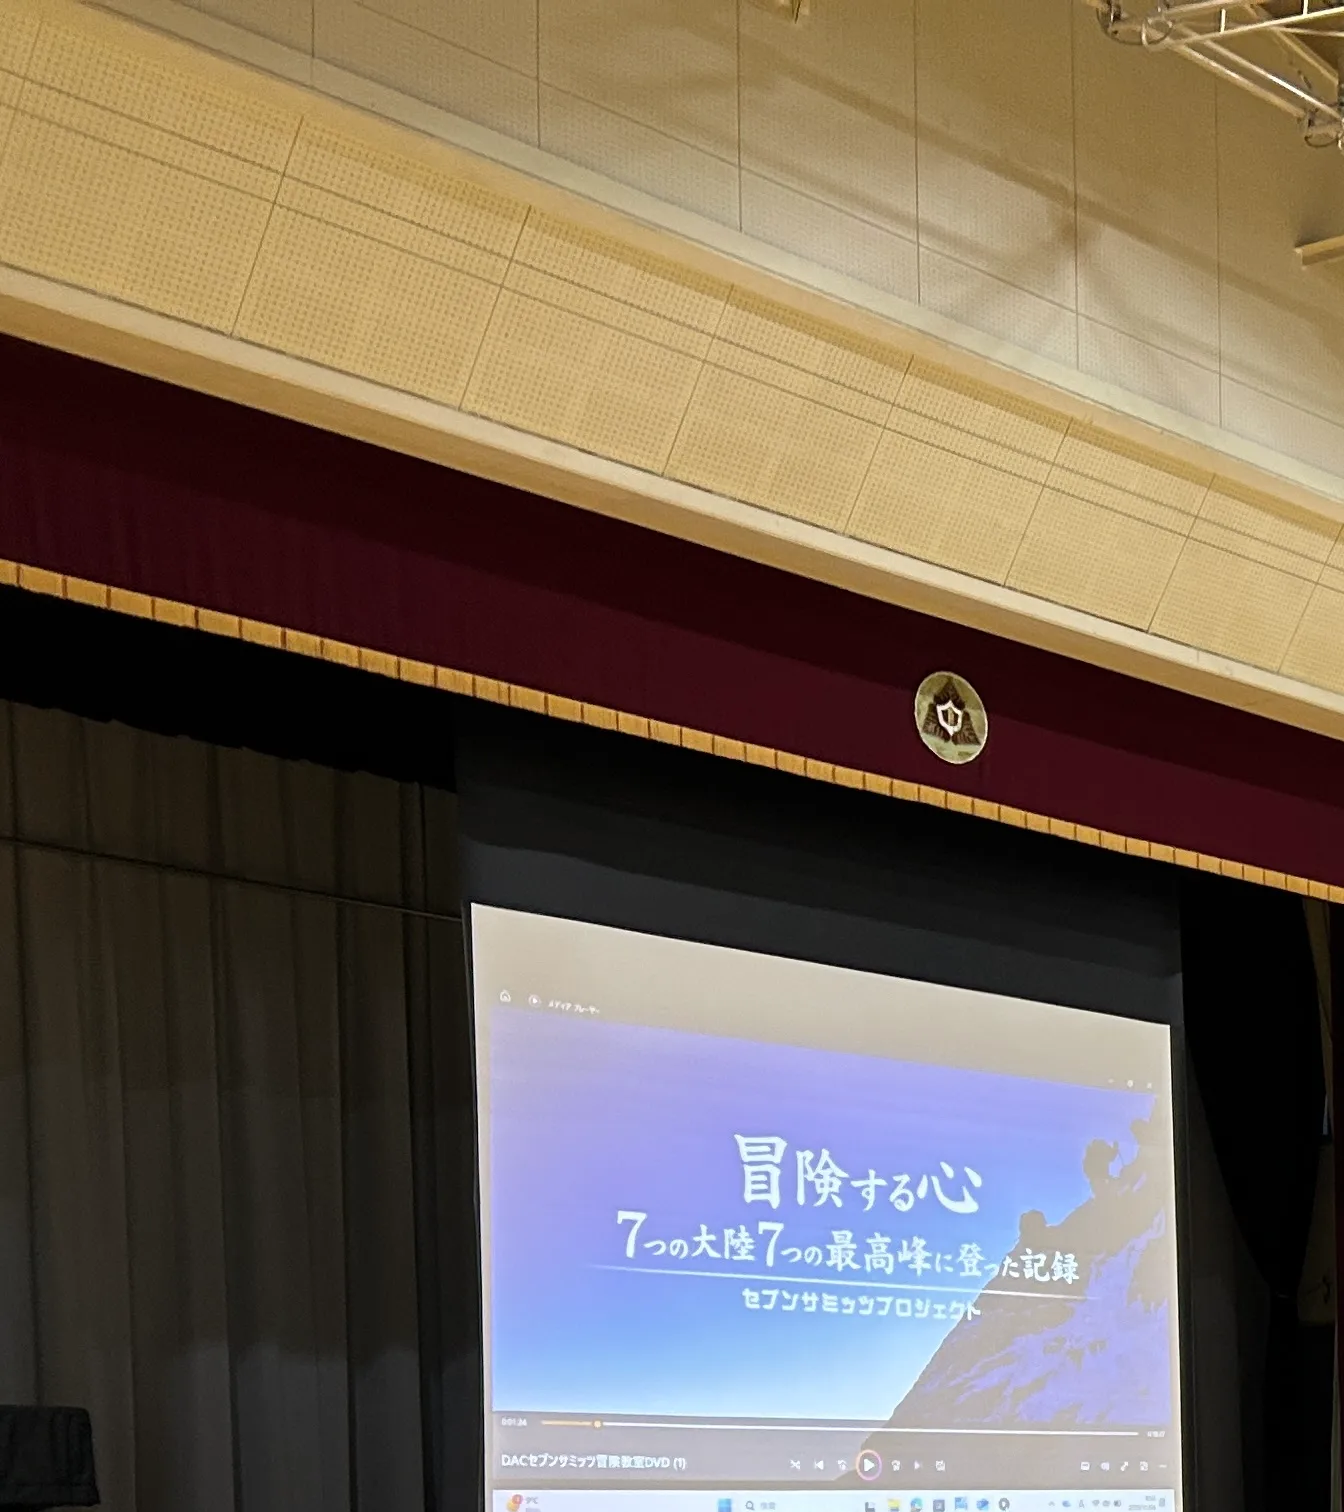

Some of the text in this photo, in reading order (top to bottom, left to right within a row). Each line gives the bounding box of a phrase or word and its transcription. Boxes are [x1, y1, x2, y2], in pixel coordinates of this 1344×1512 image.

[734, 1134, 983, 1213] 冒険する心
[616, 1210, 1080, 1285] 7つの大陸7つの最高峰に登った記録
[741, 1287, 981, 1321] セブンサミッツプロジェクト
[501, 1452, 687, 1471] DACセブンサミッツ冒険教室DVD (1)
